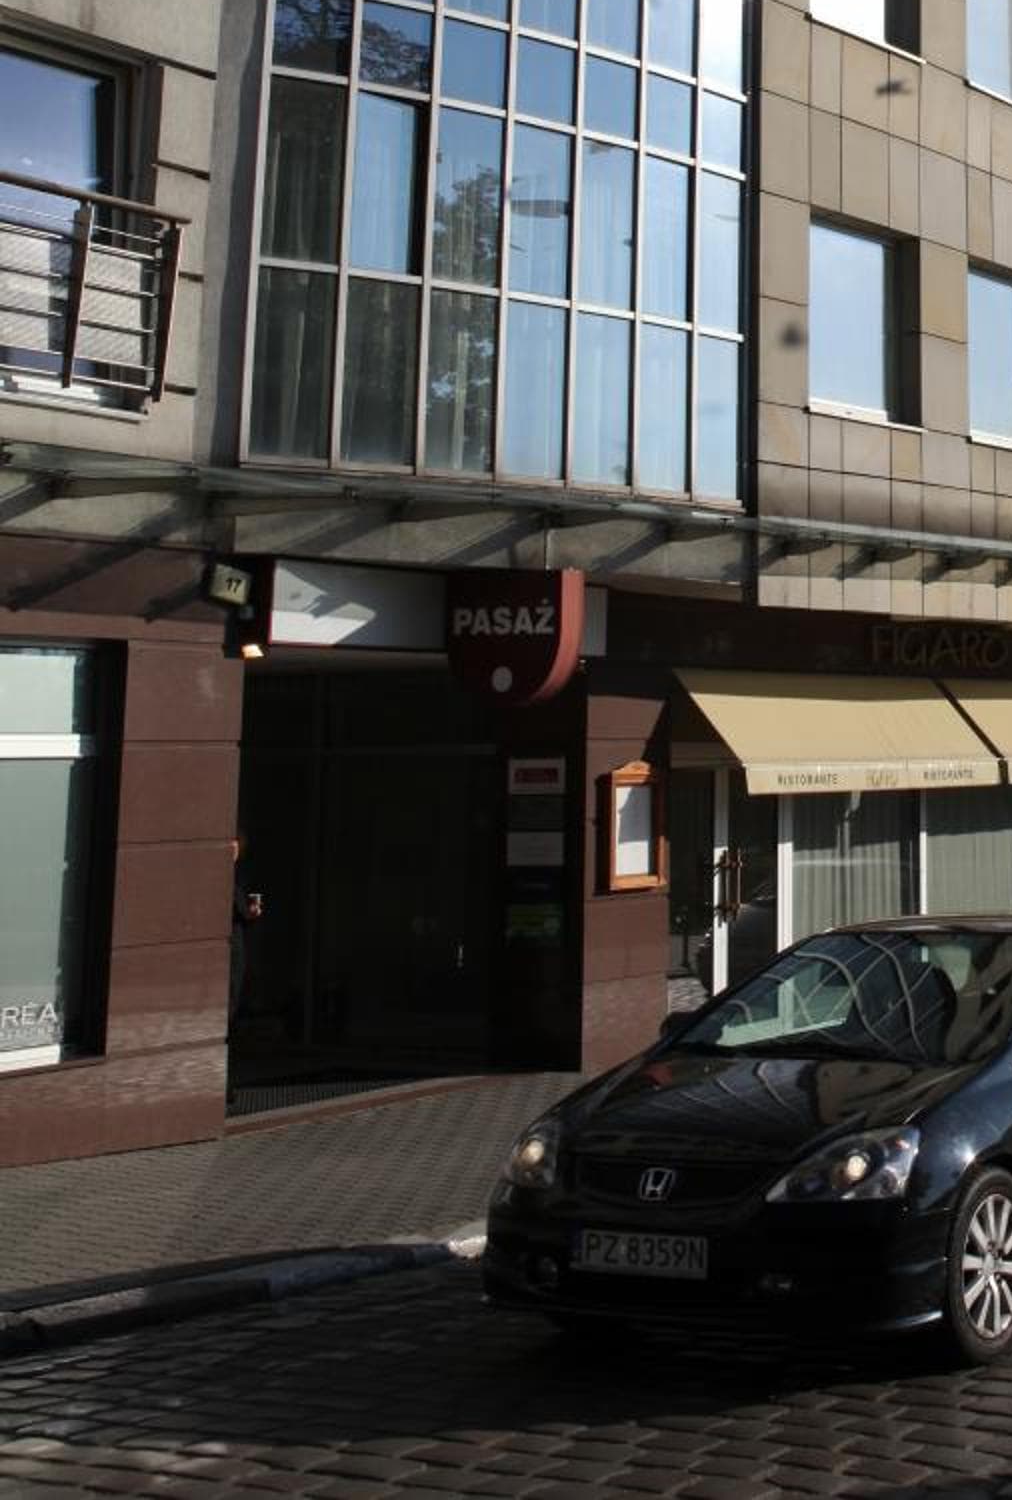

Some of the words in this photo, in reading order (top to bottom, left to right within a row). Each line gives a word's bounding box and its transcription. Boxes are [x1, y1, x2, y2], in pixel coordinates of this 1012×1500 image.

[225, 577, 242, 594] 17
[453, 598, 555, 636] PASAŻ
[872, 626, 1009, 668] FIGARO
[585, 1232, 619, 1264] PZ
[626, 1235, 704, 1269] 8359N
